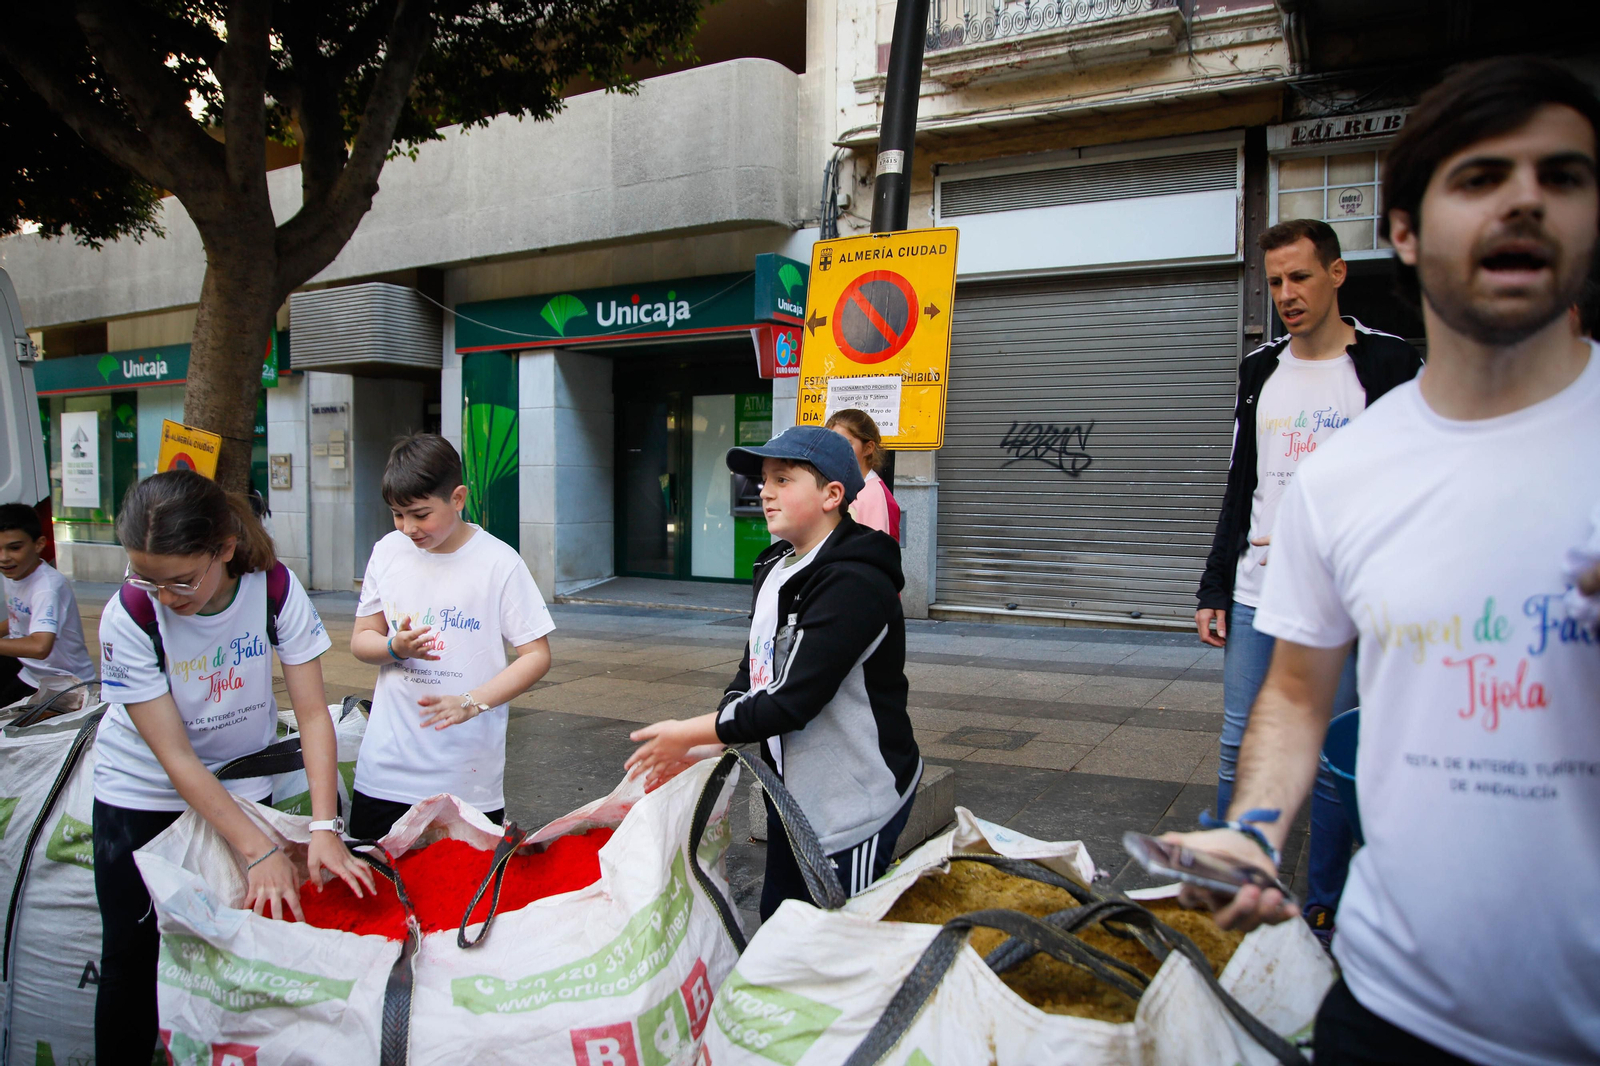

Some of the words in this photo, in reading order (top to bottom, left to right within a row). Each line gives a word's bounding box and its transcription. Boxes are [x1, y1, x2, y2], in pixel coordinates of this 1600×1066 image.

[838, 246, 894, 264] ALMERÍA
[898, 244, 948, 257] CIUDAD
[596, 290, 692, 328] Unicaja
[777, 298, 804, 316] Unicaja
[123, 353, 168, 380] Unicaja
[802, 410, 822, 421] DÍA:
[1294, 410, 1308, 428] de
[422, 607, 436, 626] de
[439, 605, 482, 633] Fátima
[1473, 596, 1513, 643] de
[213, 646, 227, 668] de
[410, 677, 442, 685] ANDALUCÍA
[434, 670, 463, 678] TURÍSTICO
[207, 711, 236, 724] INTERÉS
[210, 716, 248, 731] ANDALUCÍA
[1443, 757, 1464, 771] DE
[1450, 778, 1469, 793] DE
